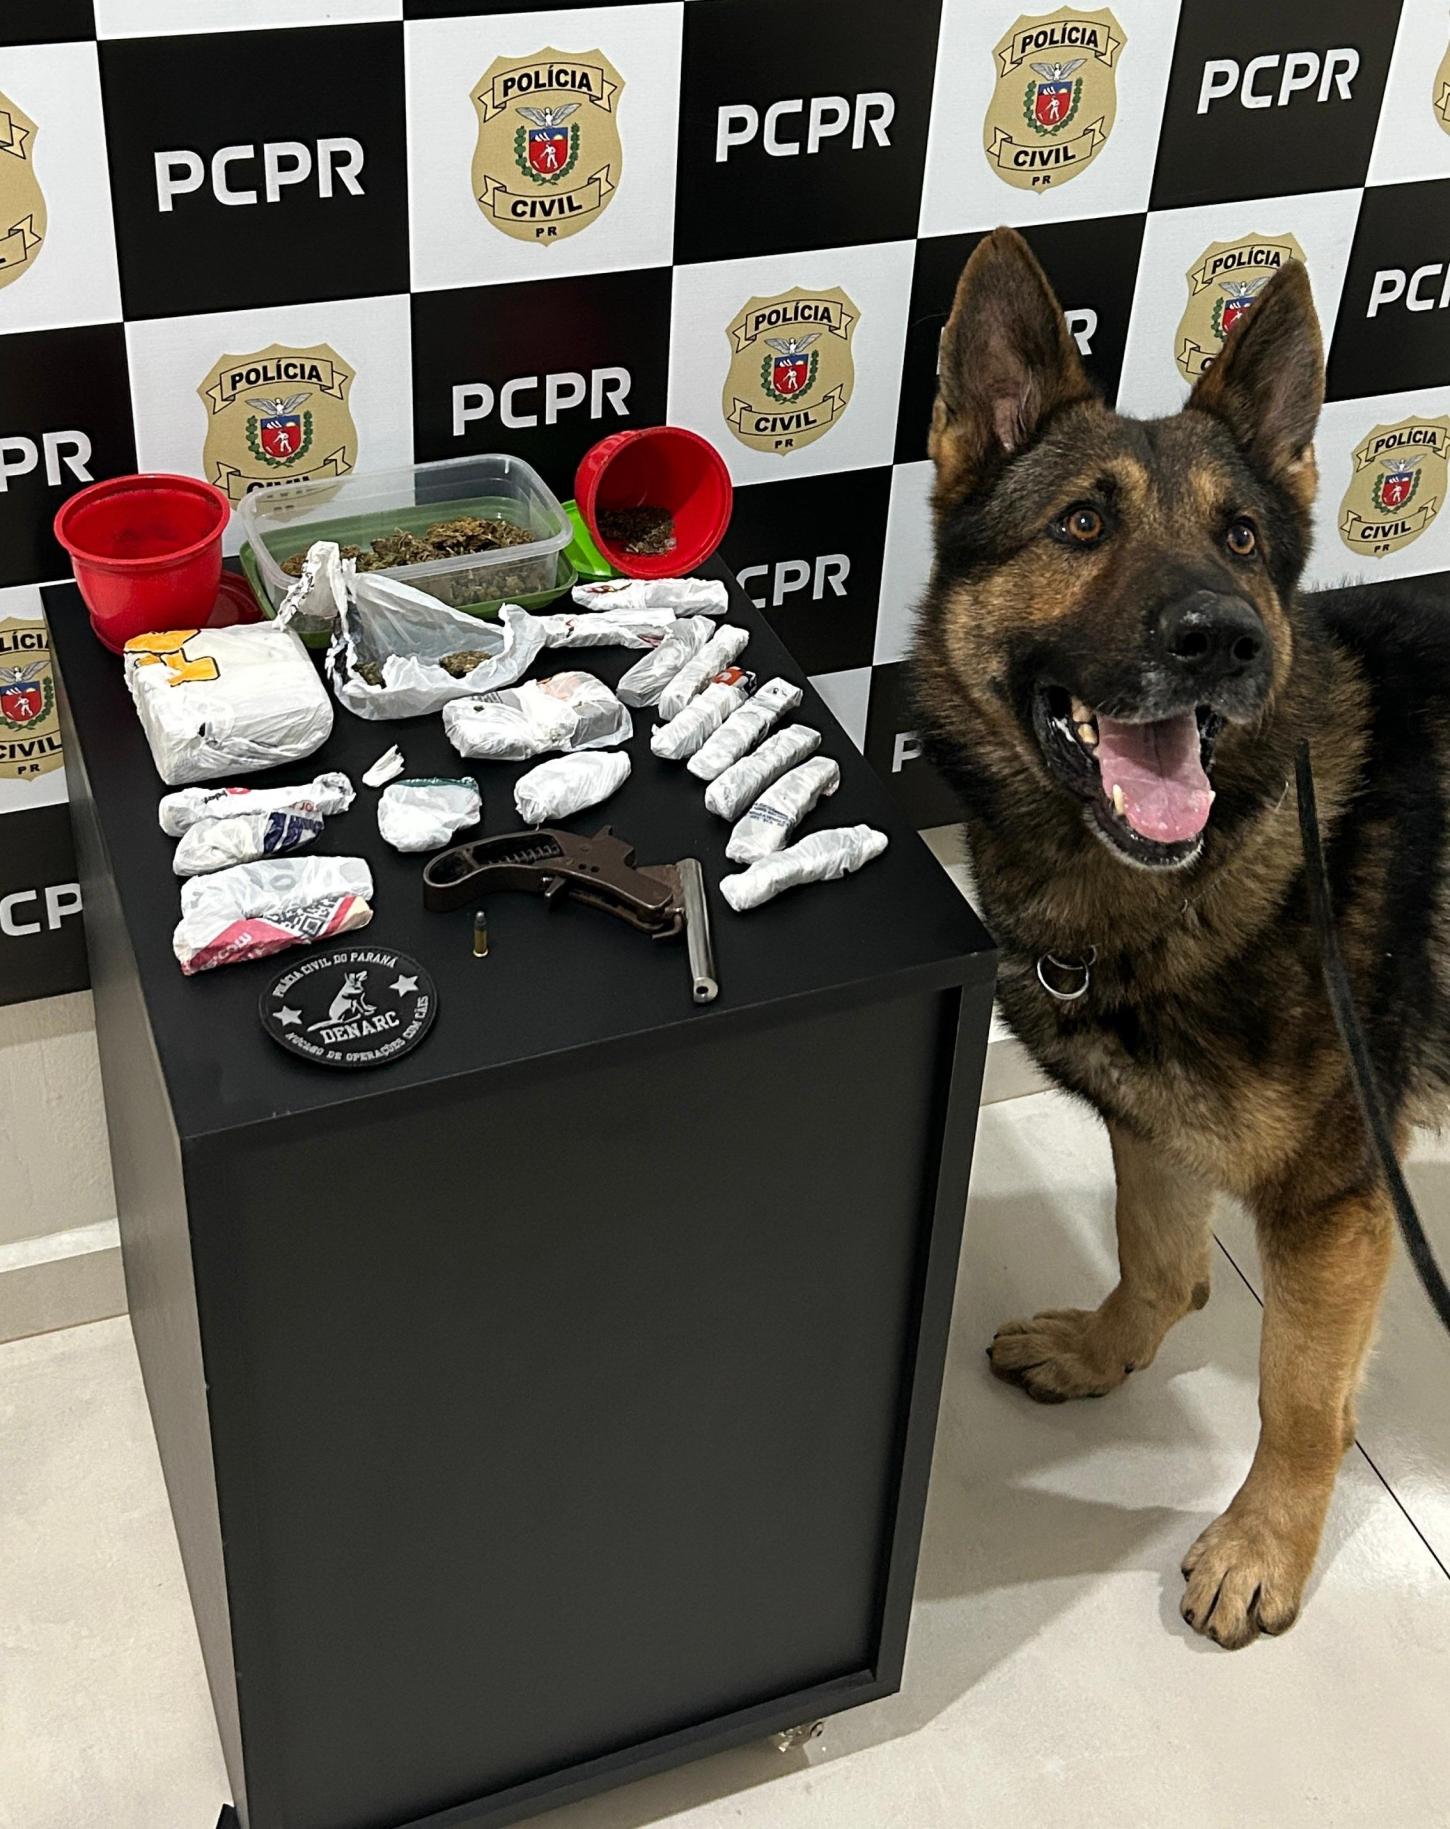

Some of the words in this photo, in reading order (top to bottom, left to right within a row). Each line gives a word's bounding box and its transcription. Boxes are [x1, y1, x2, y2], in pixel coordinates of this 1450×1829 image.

[1021, 22, 1099, 54] POLÍCIA
[502, 64, 593, 98] POLÍCIA
[1196, 48, 1360, 115] PCPR
[715, 92, 895, 163] PCPR
[1013, 146, 1076, 167] CIVIL
[154, 137, 365, 213] PCPR
[1032, 175, 1051, 186] PR
[511, 196, 583, 218] CIVIL
[535, 226, 557, 238] PR
[1211, 247, 1281, 275] POLÍCIA
[1366, 263, 1450, 318] PC
[754, 301, 832, 331] POLÍCIA
[230, 359, 323, 391] POLÍCIA
[452, 367, 632, 436] PCPR
[754, 411, 817, 433] CIVIL
[774, 438, 794, 449] PR
[1374, 429, 1437, 454] POLÍCIA
[1361, 522, 1411, 539] CIVIL
[1374, 544, 1390, 553] PR
[0, 631, 49, 651] LÍCI
[17, 763, 40, 775] PR
[302, 957, 332, 975] CIVIL
[333, 952, 348, 964] DO
[350, 952, 398, 968] PARANÁ
[320, 1010, 400, 1045] DENARC
[326, 1050, 342, 1061] DE
[402, 1019, 423, 1040] COM
